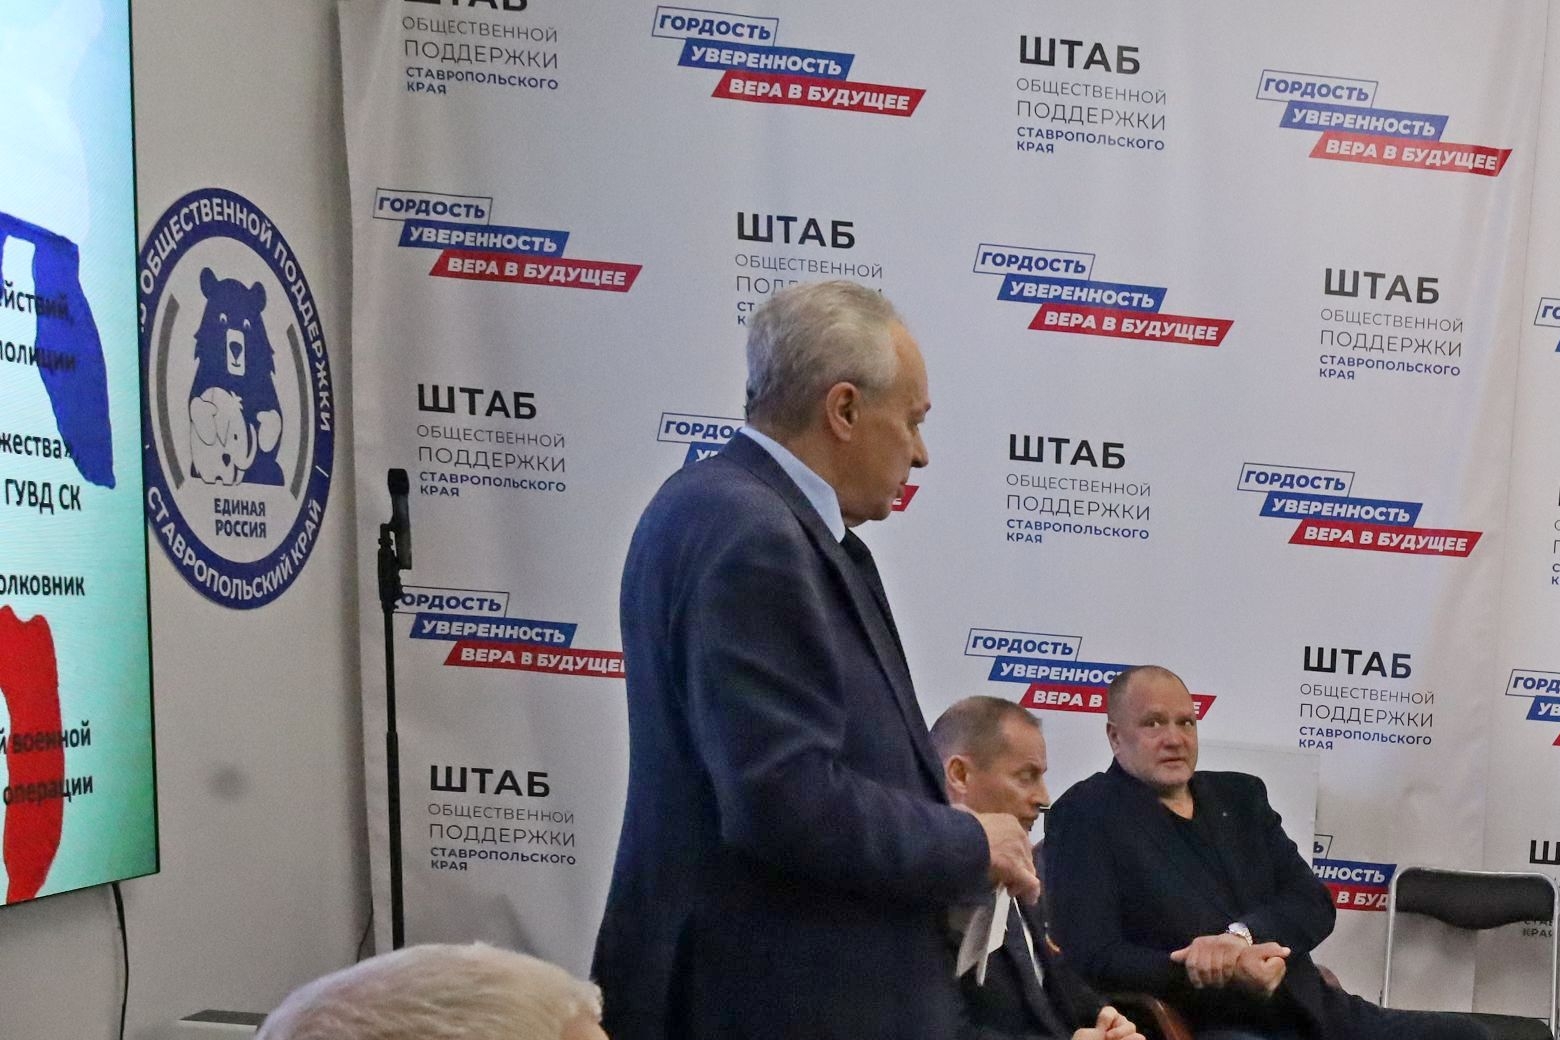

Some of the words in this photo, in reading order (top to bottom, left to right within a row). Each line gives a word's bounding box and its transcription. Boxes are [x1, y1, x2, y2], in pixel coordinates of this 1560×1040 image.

[660, 15, 770, 40] ГОРДОСТЬ
[692, 46, 841, 74] УВЕРЕННОСТЬ
[1019, 34, 1140, 75] ШТАБ
[730, 79, 782, 97] ВЕРА
[788, 84, 802, 98] В
[808, 86, 910, 110] БУДУЩЕЕ
[1016, 78, 1166, 105] ОБЩЕСТВЕННОЙ
[1265, 78, 1368, 100] ГОРДОСТЬ
[1017, 100, 1165, 130] ПОДДЕРЖКИ
[1293, 109, 1435, 136] УВЕРЕННОСТЬ
[1017, 126, 1165, 151] СТАВРОПОЛЬСКОГО
[1017, 140, 1054, 154] КРАЯ
[1326, 140, 1377, 158] ВЕРА
[1383, 146, 1397, 159] В
[1402, 148, 1497, 170] БУДУЩЕЕ
[379, 197, 484, 218] ГОРДОСТЬ
[410, 227, 556, 252] УВЕРЕННОСТЬ
[448, 258, 498, 274] ВЕРА
[504, 262, 518, 276] В
[524, 264, 626, 286] БУДУЩЕЕ
[981, 252, 1086, 273] ГОРДОСТЬ
[1010, 282, 1154, 307] УВЕРЕННОСТЬ
[1324, 268, 1440, 304] ШТАБ
[140, 198, 274, 294] ОБЩЕСТВЕННОЙ
[274, 242, 331, 432] ПОДДЕРЖКИ
[1045, 312, 1096, 328] ВЕРА
[1102, 317, 1116, 330] В
[1121, 318, 1218, 340] БУДУЩЕЕ
[1320, 308, 1463, 333] ОБЩЕСТВЕННОЙ
[1320, 329, 1462, 358] ПОДДЕРЖКИ
[1319, 368, 1355, 380] КРАЯ
[1320, 354, 1460, 376] СТАВРОПОЛЬСКОГО
[417, 383, 537, 420] ШТАБ
[416, 424, 565, 448] ОБЩЕСТВЕННОЙ
[418, 446, 565, 473] ПОДДЕРЖКИ
[1009, 434, 1126, 470] ШТАБ
[419, 470, 566, 493] СТАВРОПОЛЬСКОГО
[420, 485, 460, 497] КРАЯ
[1006, 473, 1150, 496] ОБЩЕСТВЕННОЙ
[1245, 471, 1345, 490] ГОРДОСТЬ
[5, 478, 55, 516] ГУВД
[58, 484, 82, 512] СК
[214, 498, 266, 517] ЕДИНАЯ
[1007, 494, 1150, 521] ПОДДЕРЖКИ
[1272, 498, 1410, 522] УВЕРЕННОСТЬ
[215, 520, 267, 539] РОССИЯ
[1006, 518, 1149, 540] СТАВРОПОЛЬСКОГО
[1006, 532, 1042, 543] КРАЯ
[1304, 527, 1354, 542] ВЕРА
[1360, 531, 1373, 544] В
[1378, 533, 1468, 552] БУДУЩЕЕ
[148, 487, 293, 600] СТАВРОПОЛЬСКИЙ
[291, 499, 321, 566] КРАЙ
[972, 636, 1073, 656] ГОРДОСТЬ
[1303, 646, 1412, 679] ШТАБ
[1033, 690, 1084, 708] ВЕРА
[1089, 694, 1103, 708] В
[1300, 683, 1434, 704] ОБЩЕСТВЕННОЙ
[1300, 703, 1433, 727] ПОДДЕРЖКИ
[1299, 726, 1432, 745] СТАВРОПОЛЬСКОГО
[1299, 738, 1333, 750] КРАЯ
[430, 764, 550, 798] ШТАБ
[428, 803, 574, 824] ОБЩЕСТВЕННОЙ
[429, 823, 575, 848] ПОДДЕРЖКИ
[430, 846, 576, 865] СТАВРОПОЛЬСКОГО
[431, 860, 468, 871] КРАЯ
